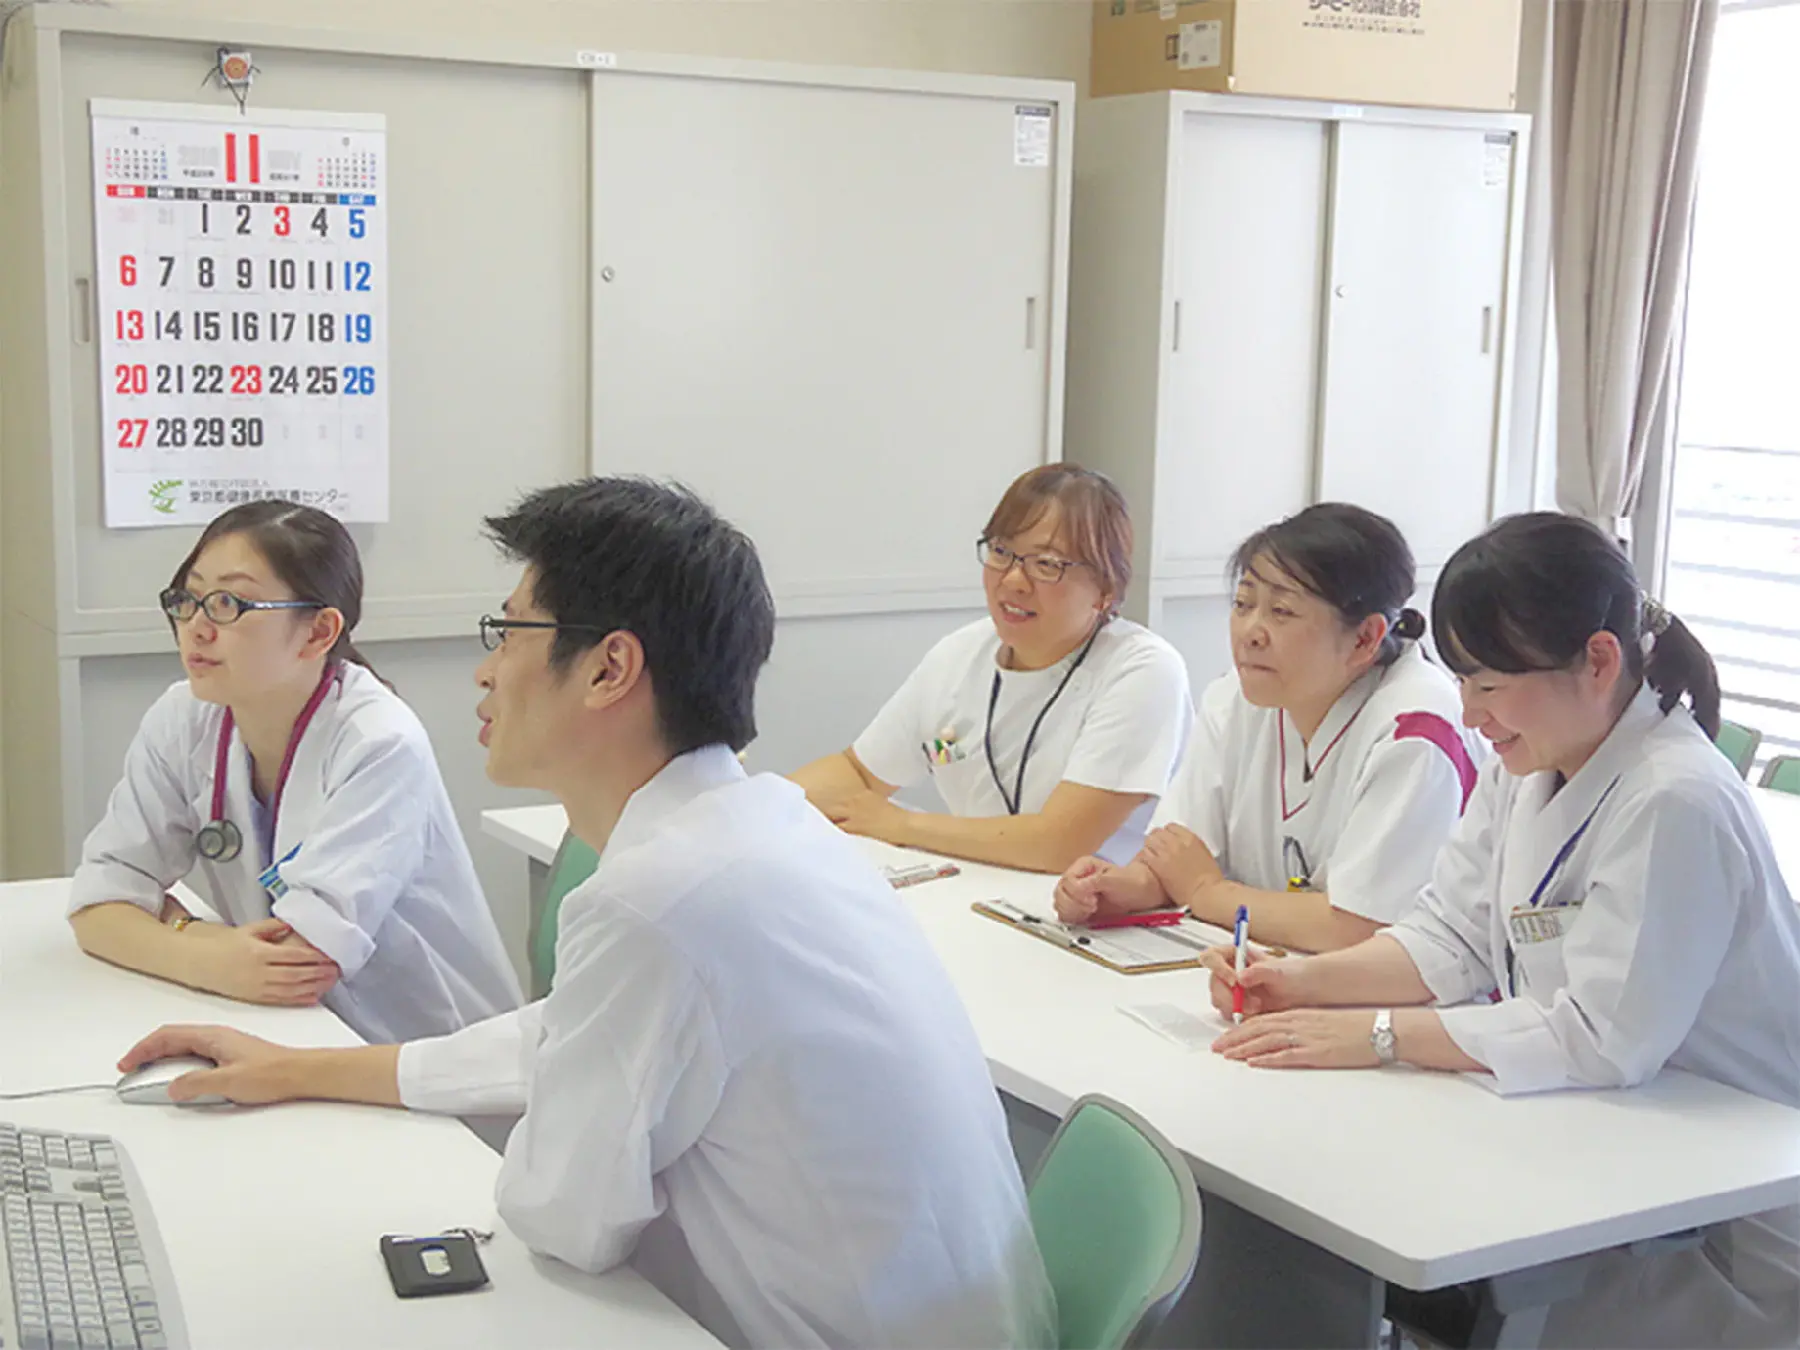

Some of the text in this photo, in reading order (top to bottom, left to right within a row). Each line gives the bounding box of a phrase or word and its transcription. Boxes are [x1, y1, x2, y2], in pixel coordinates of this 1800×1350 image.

[224, 132, 260, 184] 11
[201, 203, 209, 234] 1
[236, 204, 251, 235] 2
[274, 205, 290, 237] 3
[311, 207, 328, 237] 4
[349, 209, 365, 239] 5
[119, 255, 371, 292] 6 7 8 9 10 11 12
[116, 310, 372, 343] 13 14 15 16 17 18 19
[115, 364, 375, 396] 20 21 22 23 24 25 26
[117, 418, 149, 448] 27
[156, 418, 187, 448] 28
[193, 417, 224, 447] 29
[231, 417, 263, 447] 30
